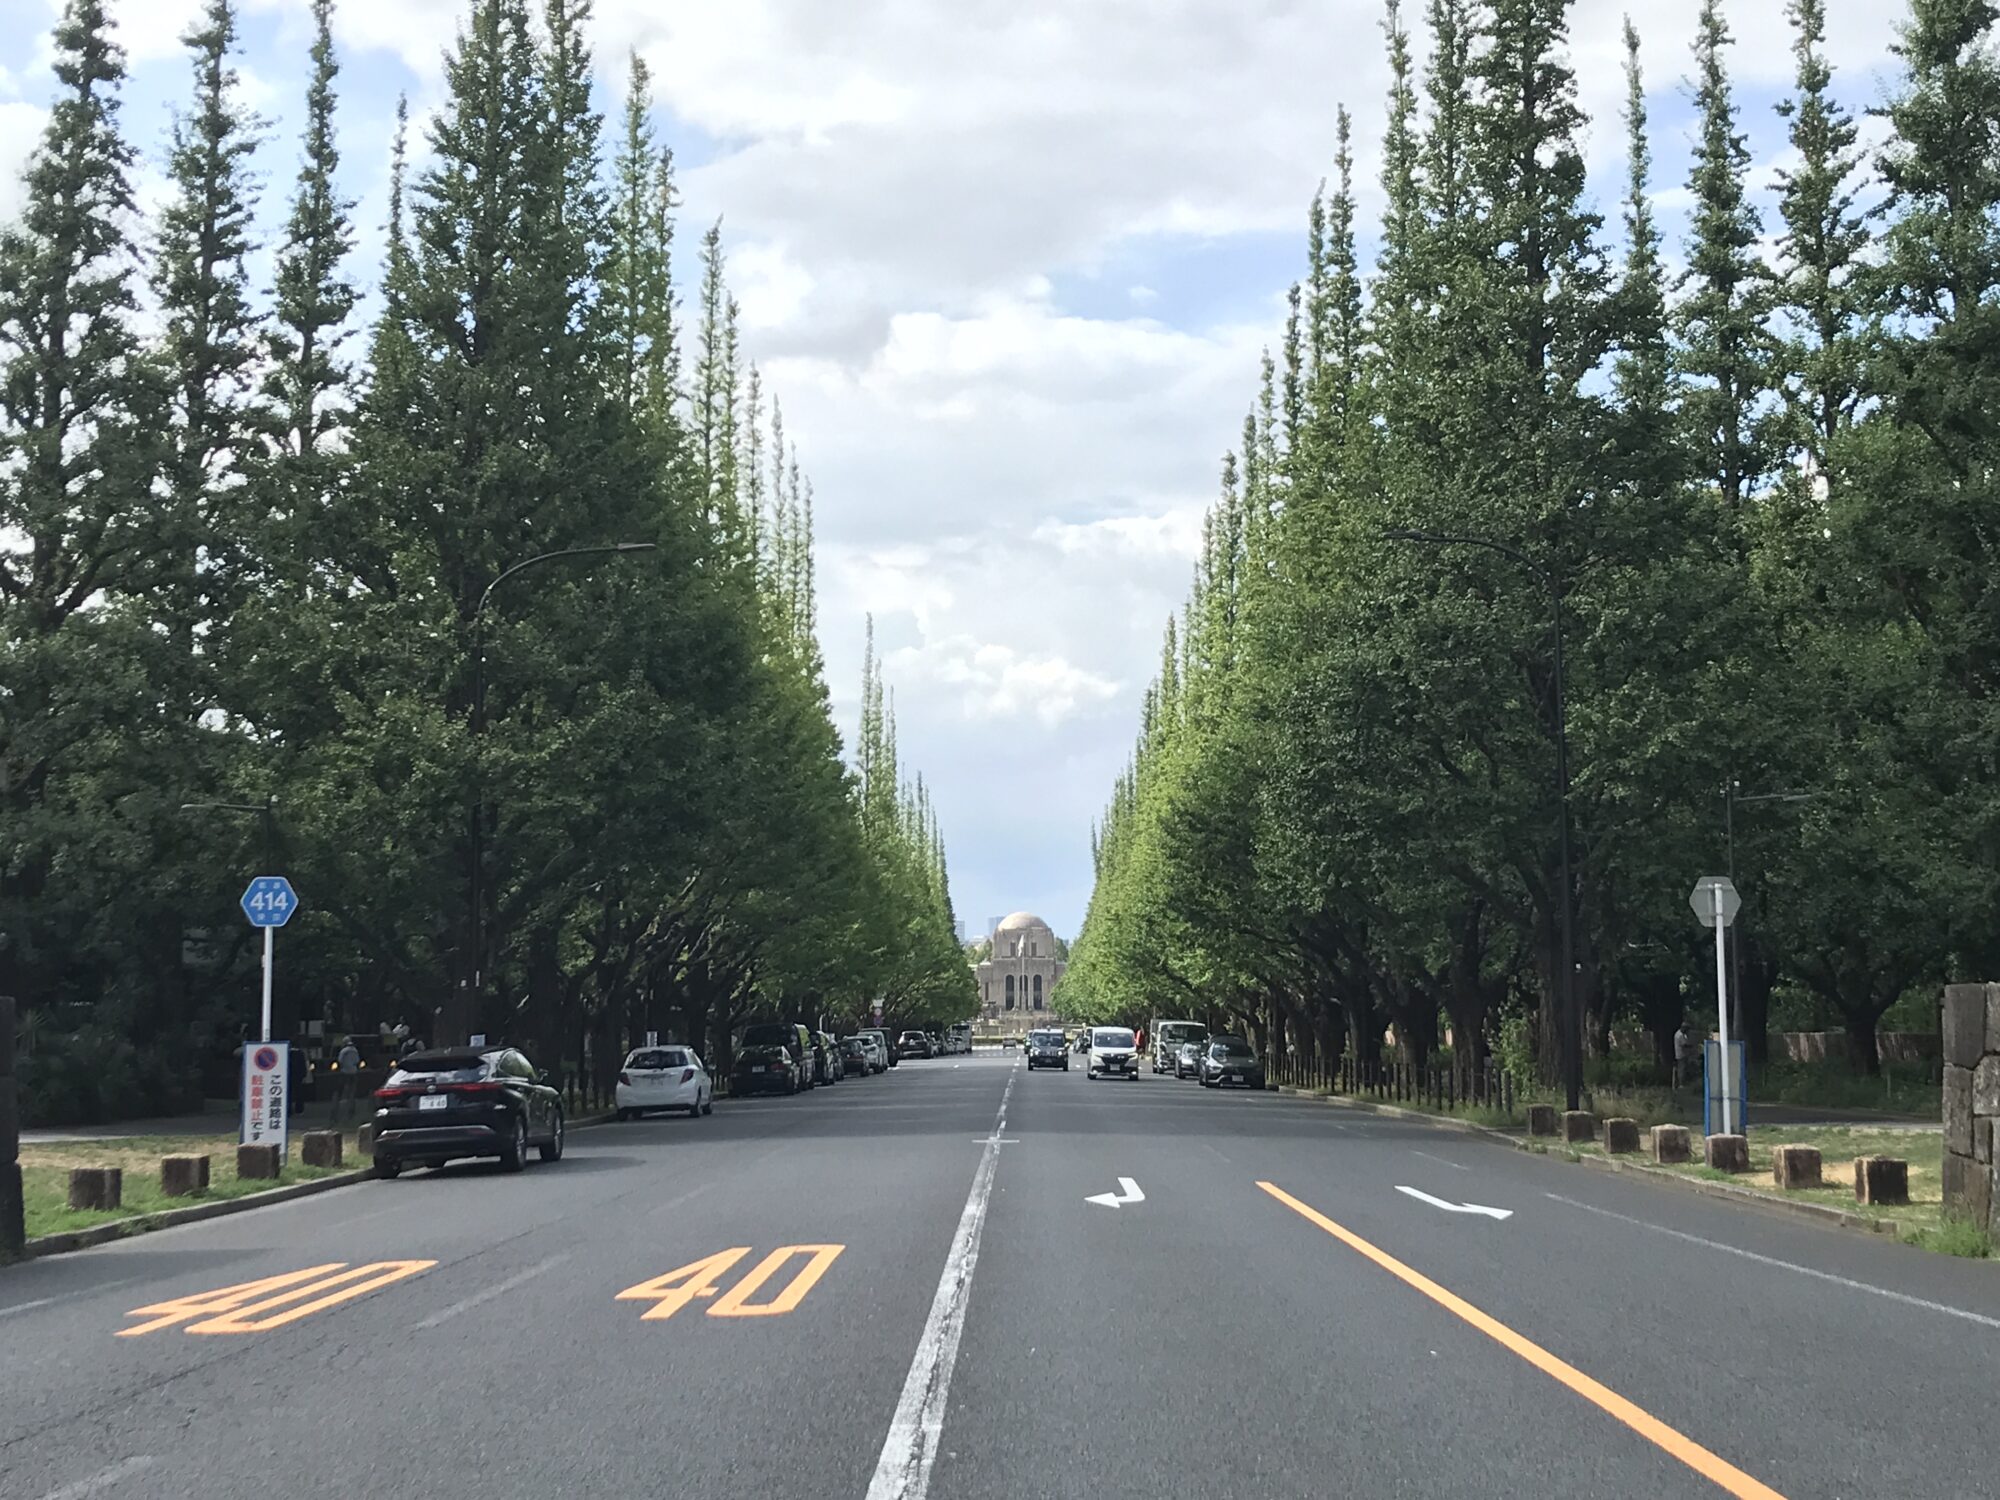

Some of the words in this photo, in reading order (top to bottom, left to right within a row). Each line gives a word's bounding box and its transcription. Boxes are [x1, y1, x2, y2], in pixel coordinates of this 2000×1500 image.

[250, 891, 288, 911] 414
[268, 1074, 283, 1130] この道路は
[116, 1261, 437, 1336] 40
[616, 1244, 845, 1319] 40
